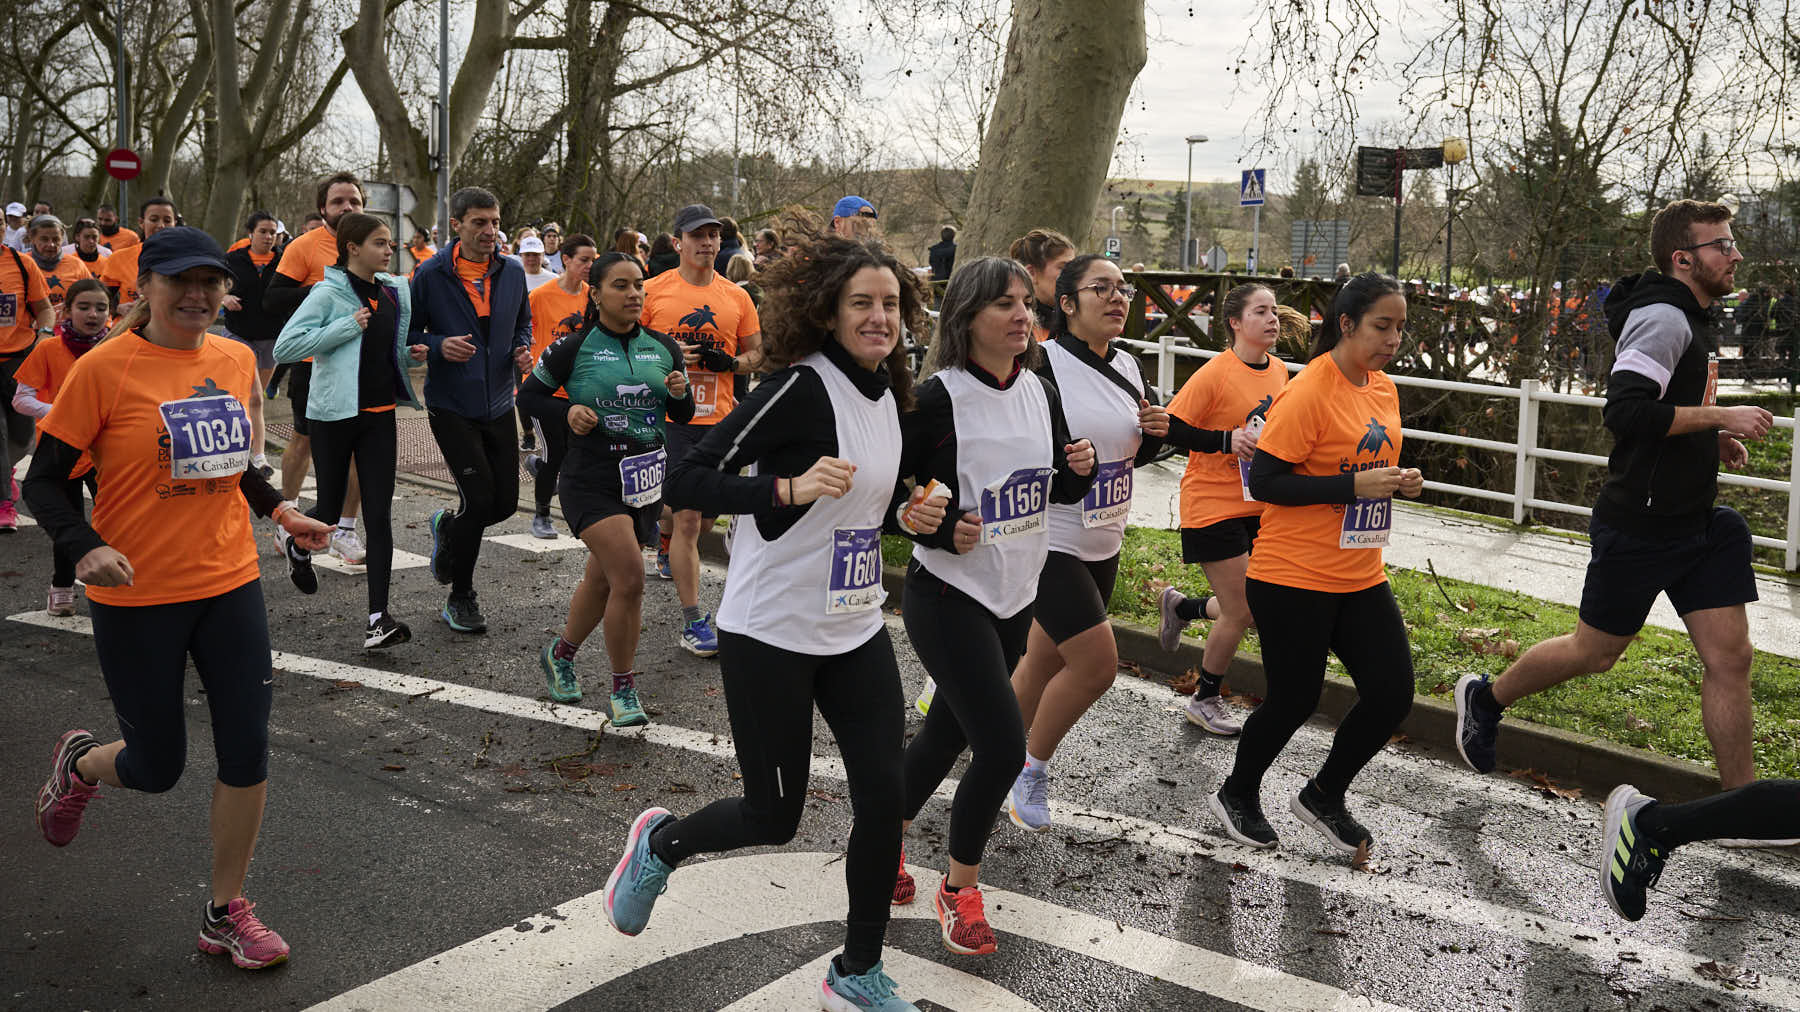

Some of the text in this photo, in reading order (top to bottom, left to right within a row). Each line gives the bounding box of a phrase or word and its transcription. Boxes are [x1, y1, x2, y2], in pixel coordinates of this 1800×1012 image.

[1109, 239, 1118, 249] P
[224, 400, 243, 412] 5KM
[182, 416, 246, 455] 1034
[630, 463, 662, 493] 1806
[1092, 473, 1130, 507] 1169
[990, 480, 1042, 519] 1156
[1355, 501, 1388, 529] 1167
